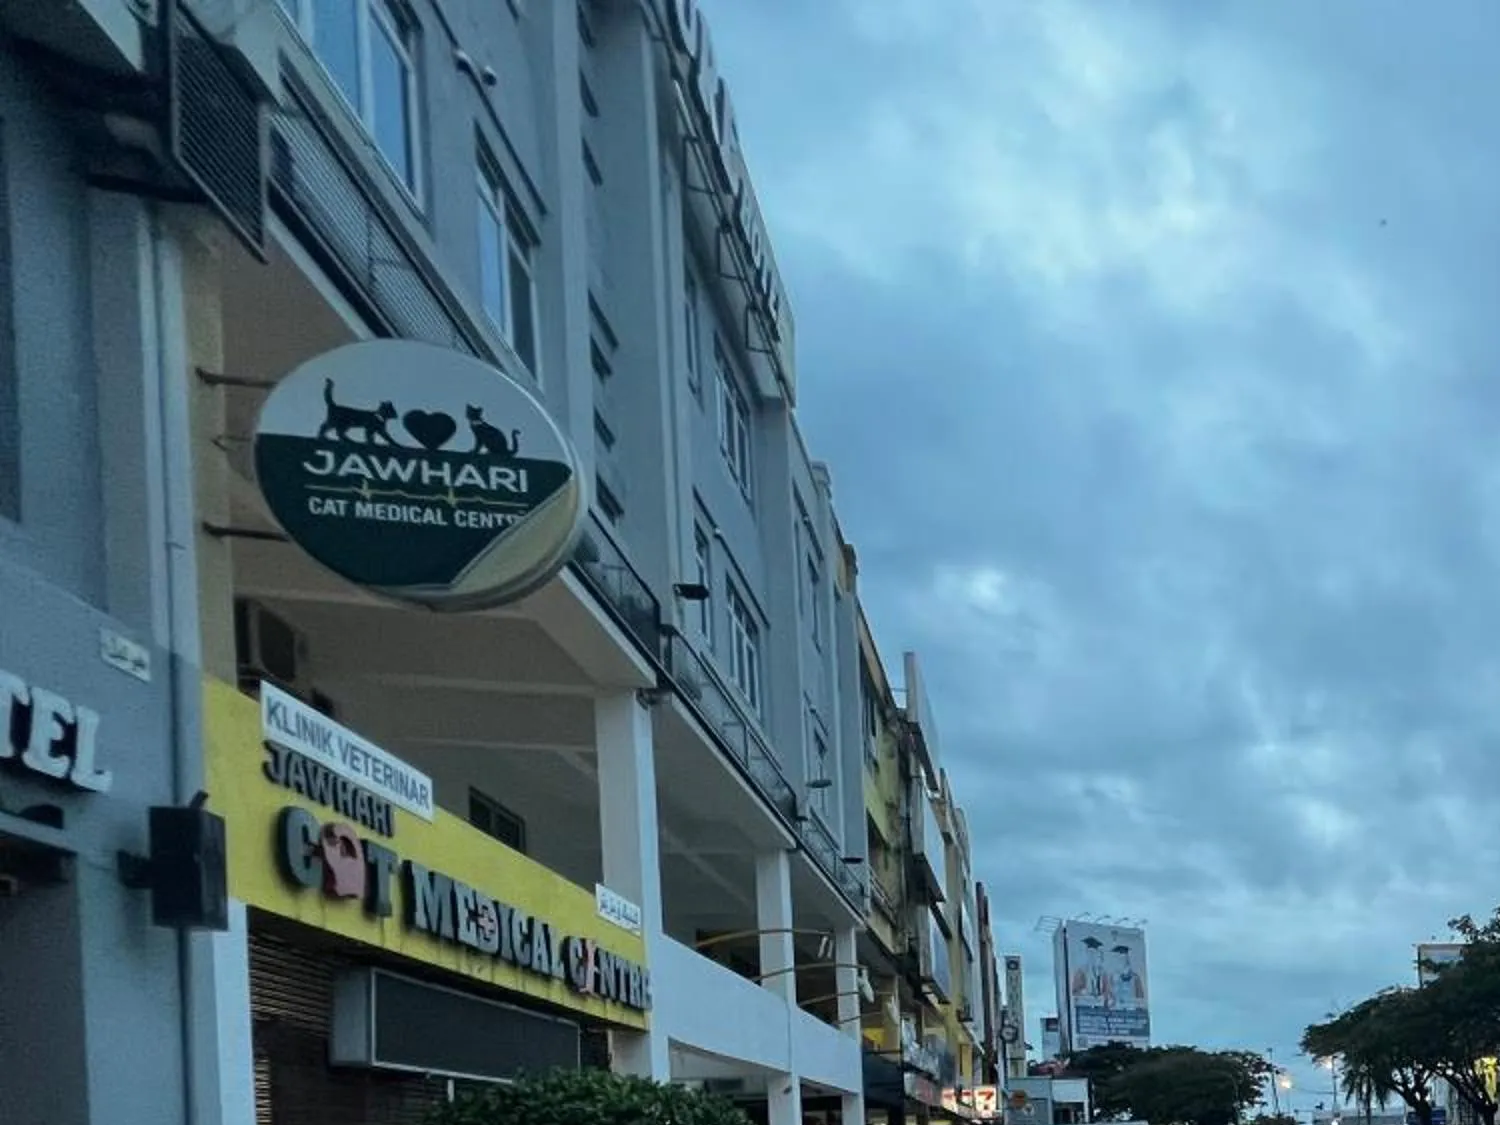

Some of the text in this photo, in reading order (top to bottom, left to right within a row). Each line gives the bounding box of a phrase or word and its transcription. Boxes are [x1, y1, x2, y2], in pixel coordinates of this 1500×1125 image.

[303, 449, 528, 493] JAWHARI
[308, 496, 349, 517] CAT
[354, 498, 448, 527] MEDICAL
[266, 695, 431, 810] KLINIK VETERINAR
[402, 860, 566, 981] MEDICAL
